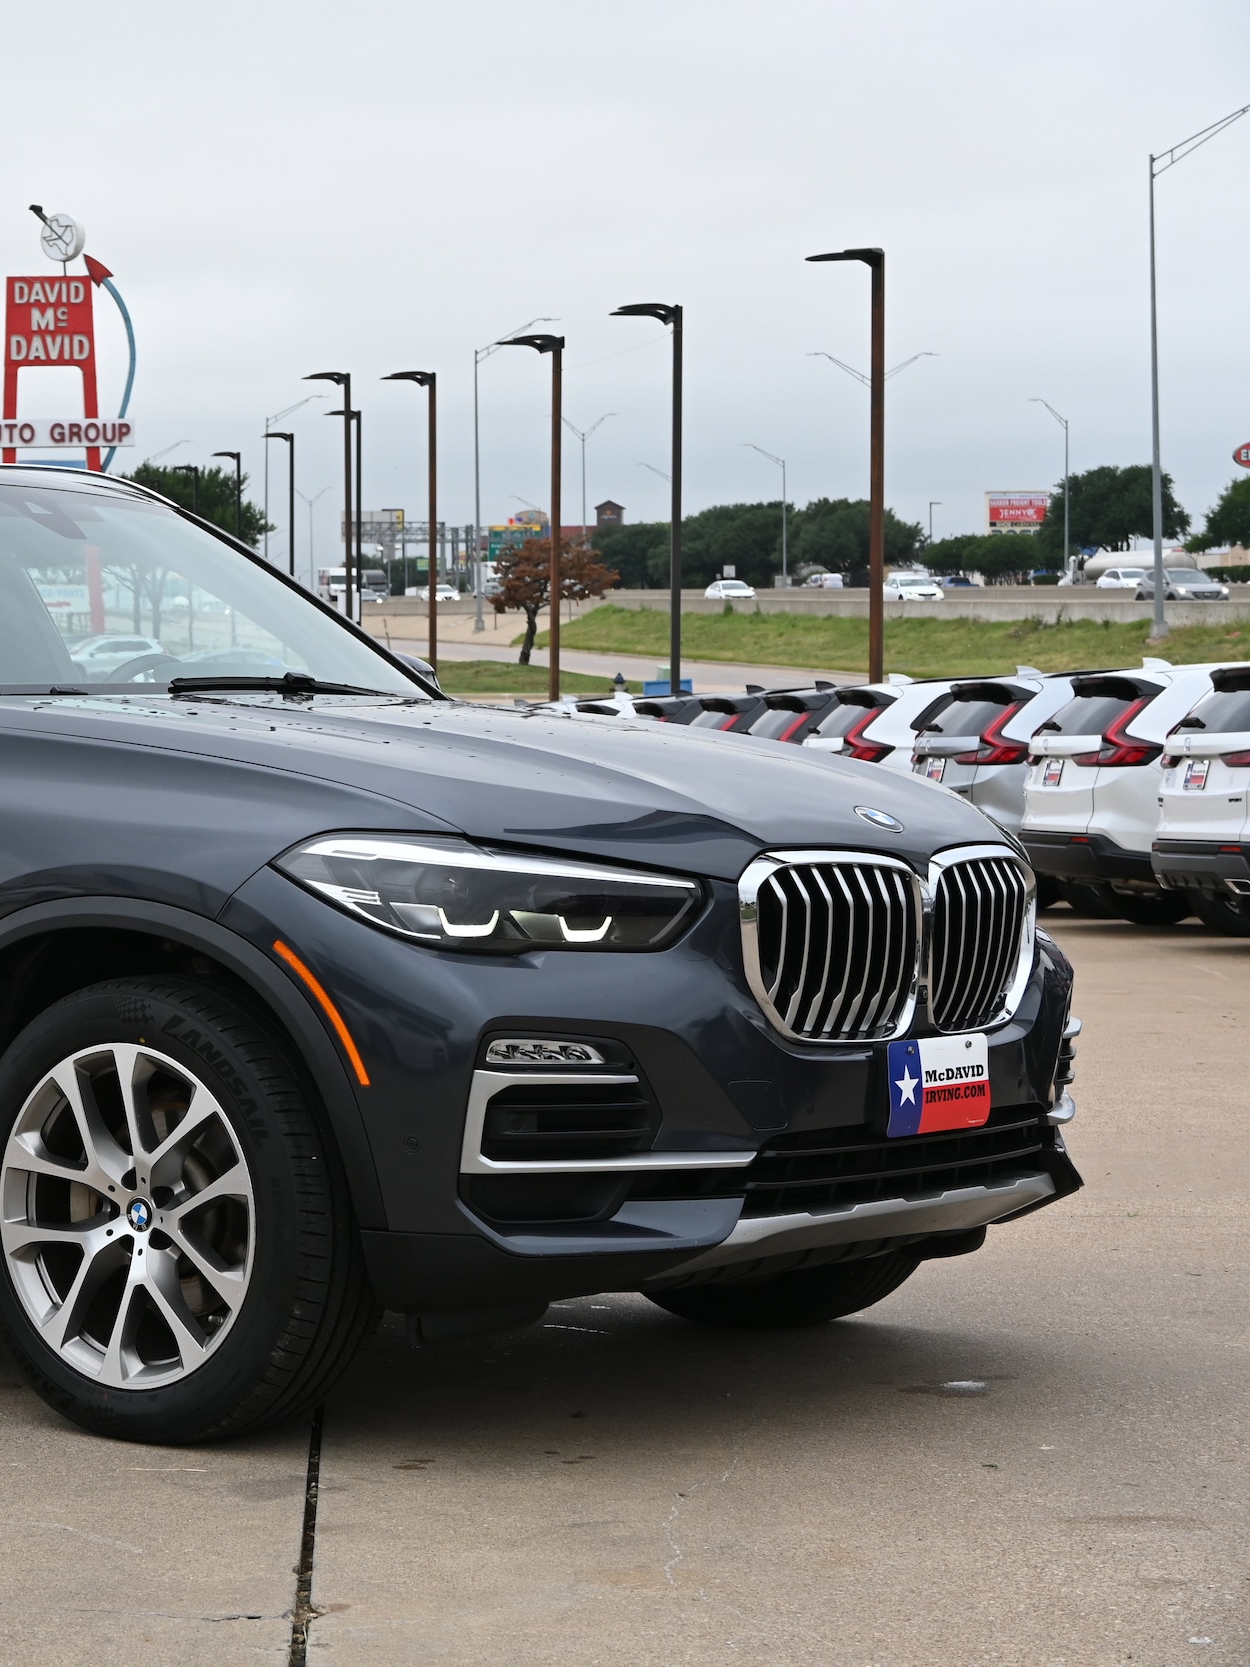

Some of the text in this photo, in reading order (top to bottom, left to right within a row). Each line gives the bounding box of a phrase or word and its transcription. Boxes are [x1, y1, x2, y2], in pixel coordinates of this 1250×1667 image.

[14, 281, 85, 304] DAVID
[31, 306, 68, 331] Mc
[10, 334, 90, 360] DAVID
[50, 422, 131, 444] GROUP
[161, 1014, 271, 1147] LANDSAIL
[925, 1064, 984, 1083] McDAVID
[925, 1084, 986, 1104] IRVING.COM
